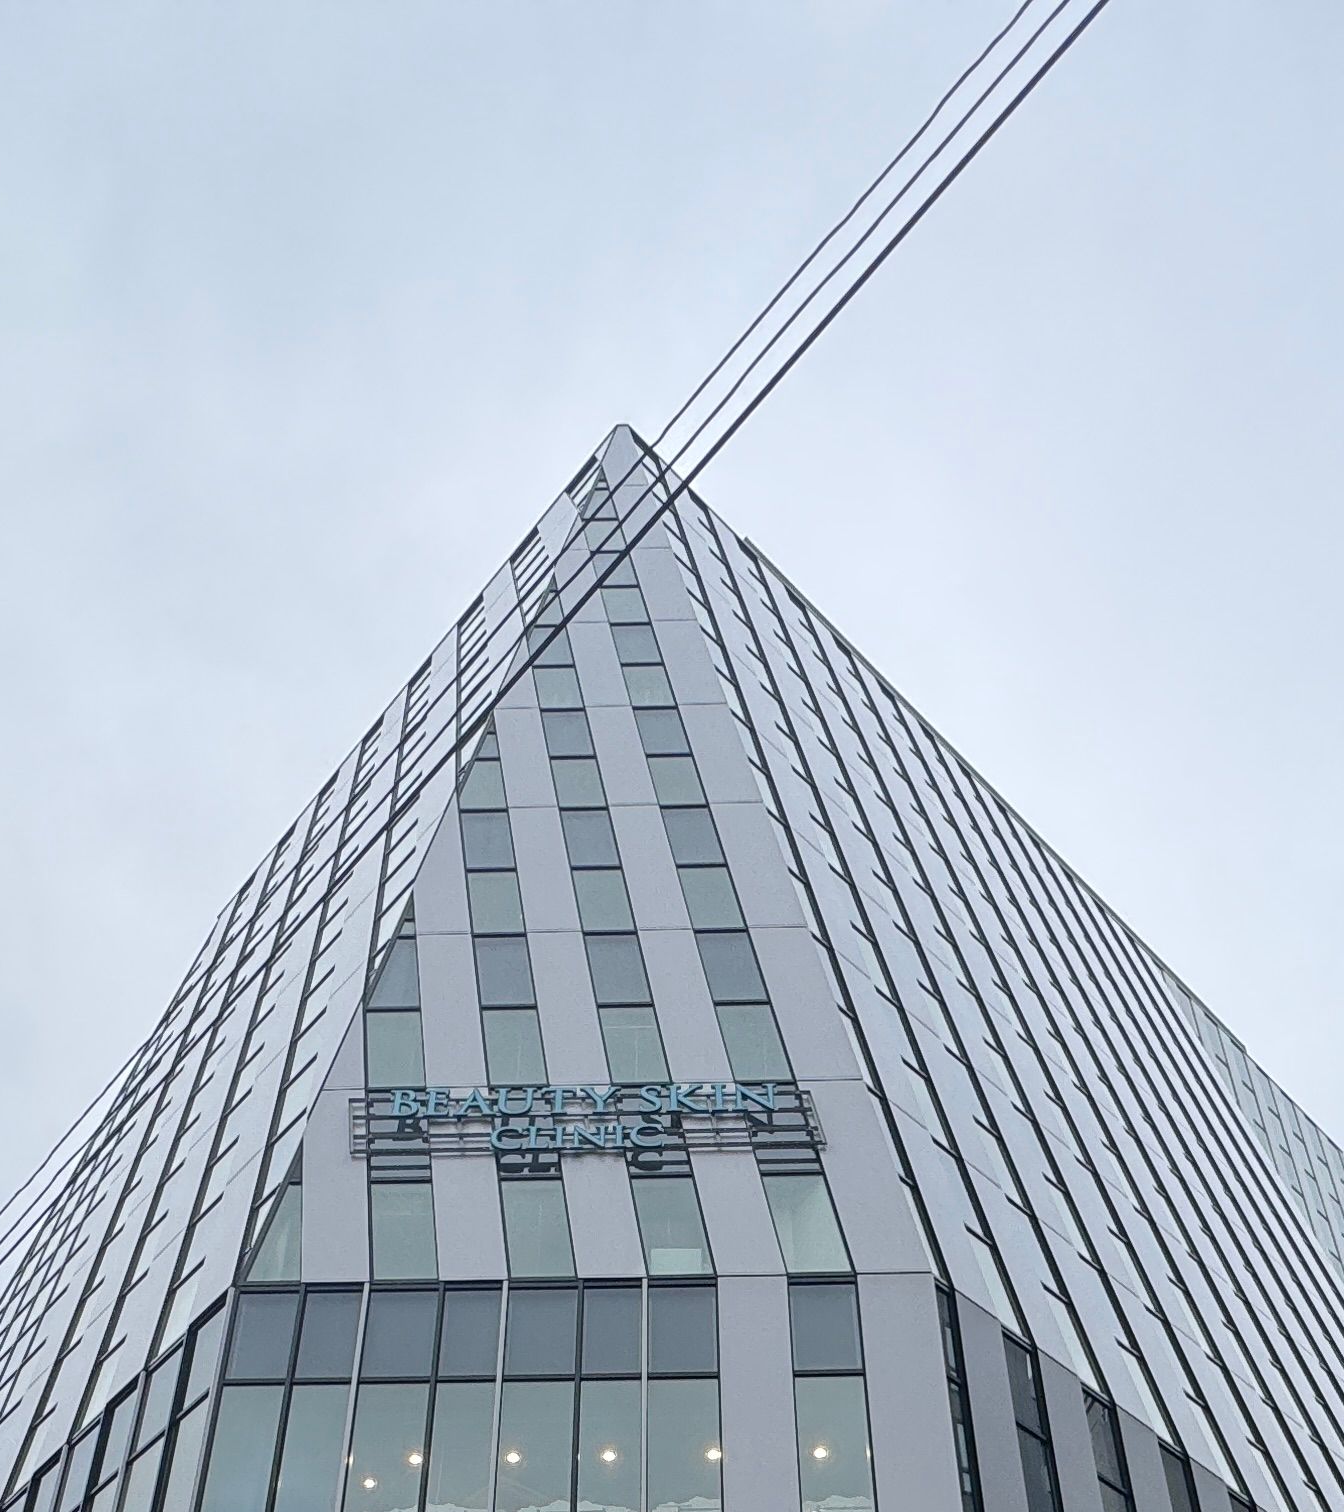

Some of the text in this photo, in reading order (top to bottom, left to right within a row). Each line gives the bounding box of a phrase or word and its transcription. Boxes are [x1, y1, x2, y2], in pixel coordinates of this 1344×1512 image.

[389, 1083, 779, 1118] BEAUTY SKIN
[489, 1123, 665, 1151] CLINIC
